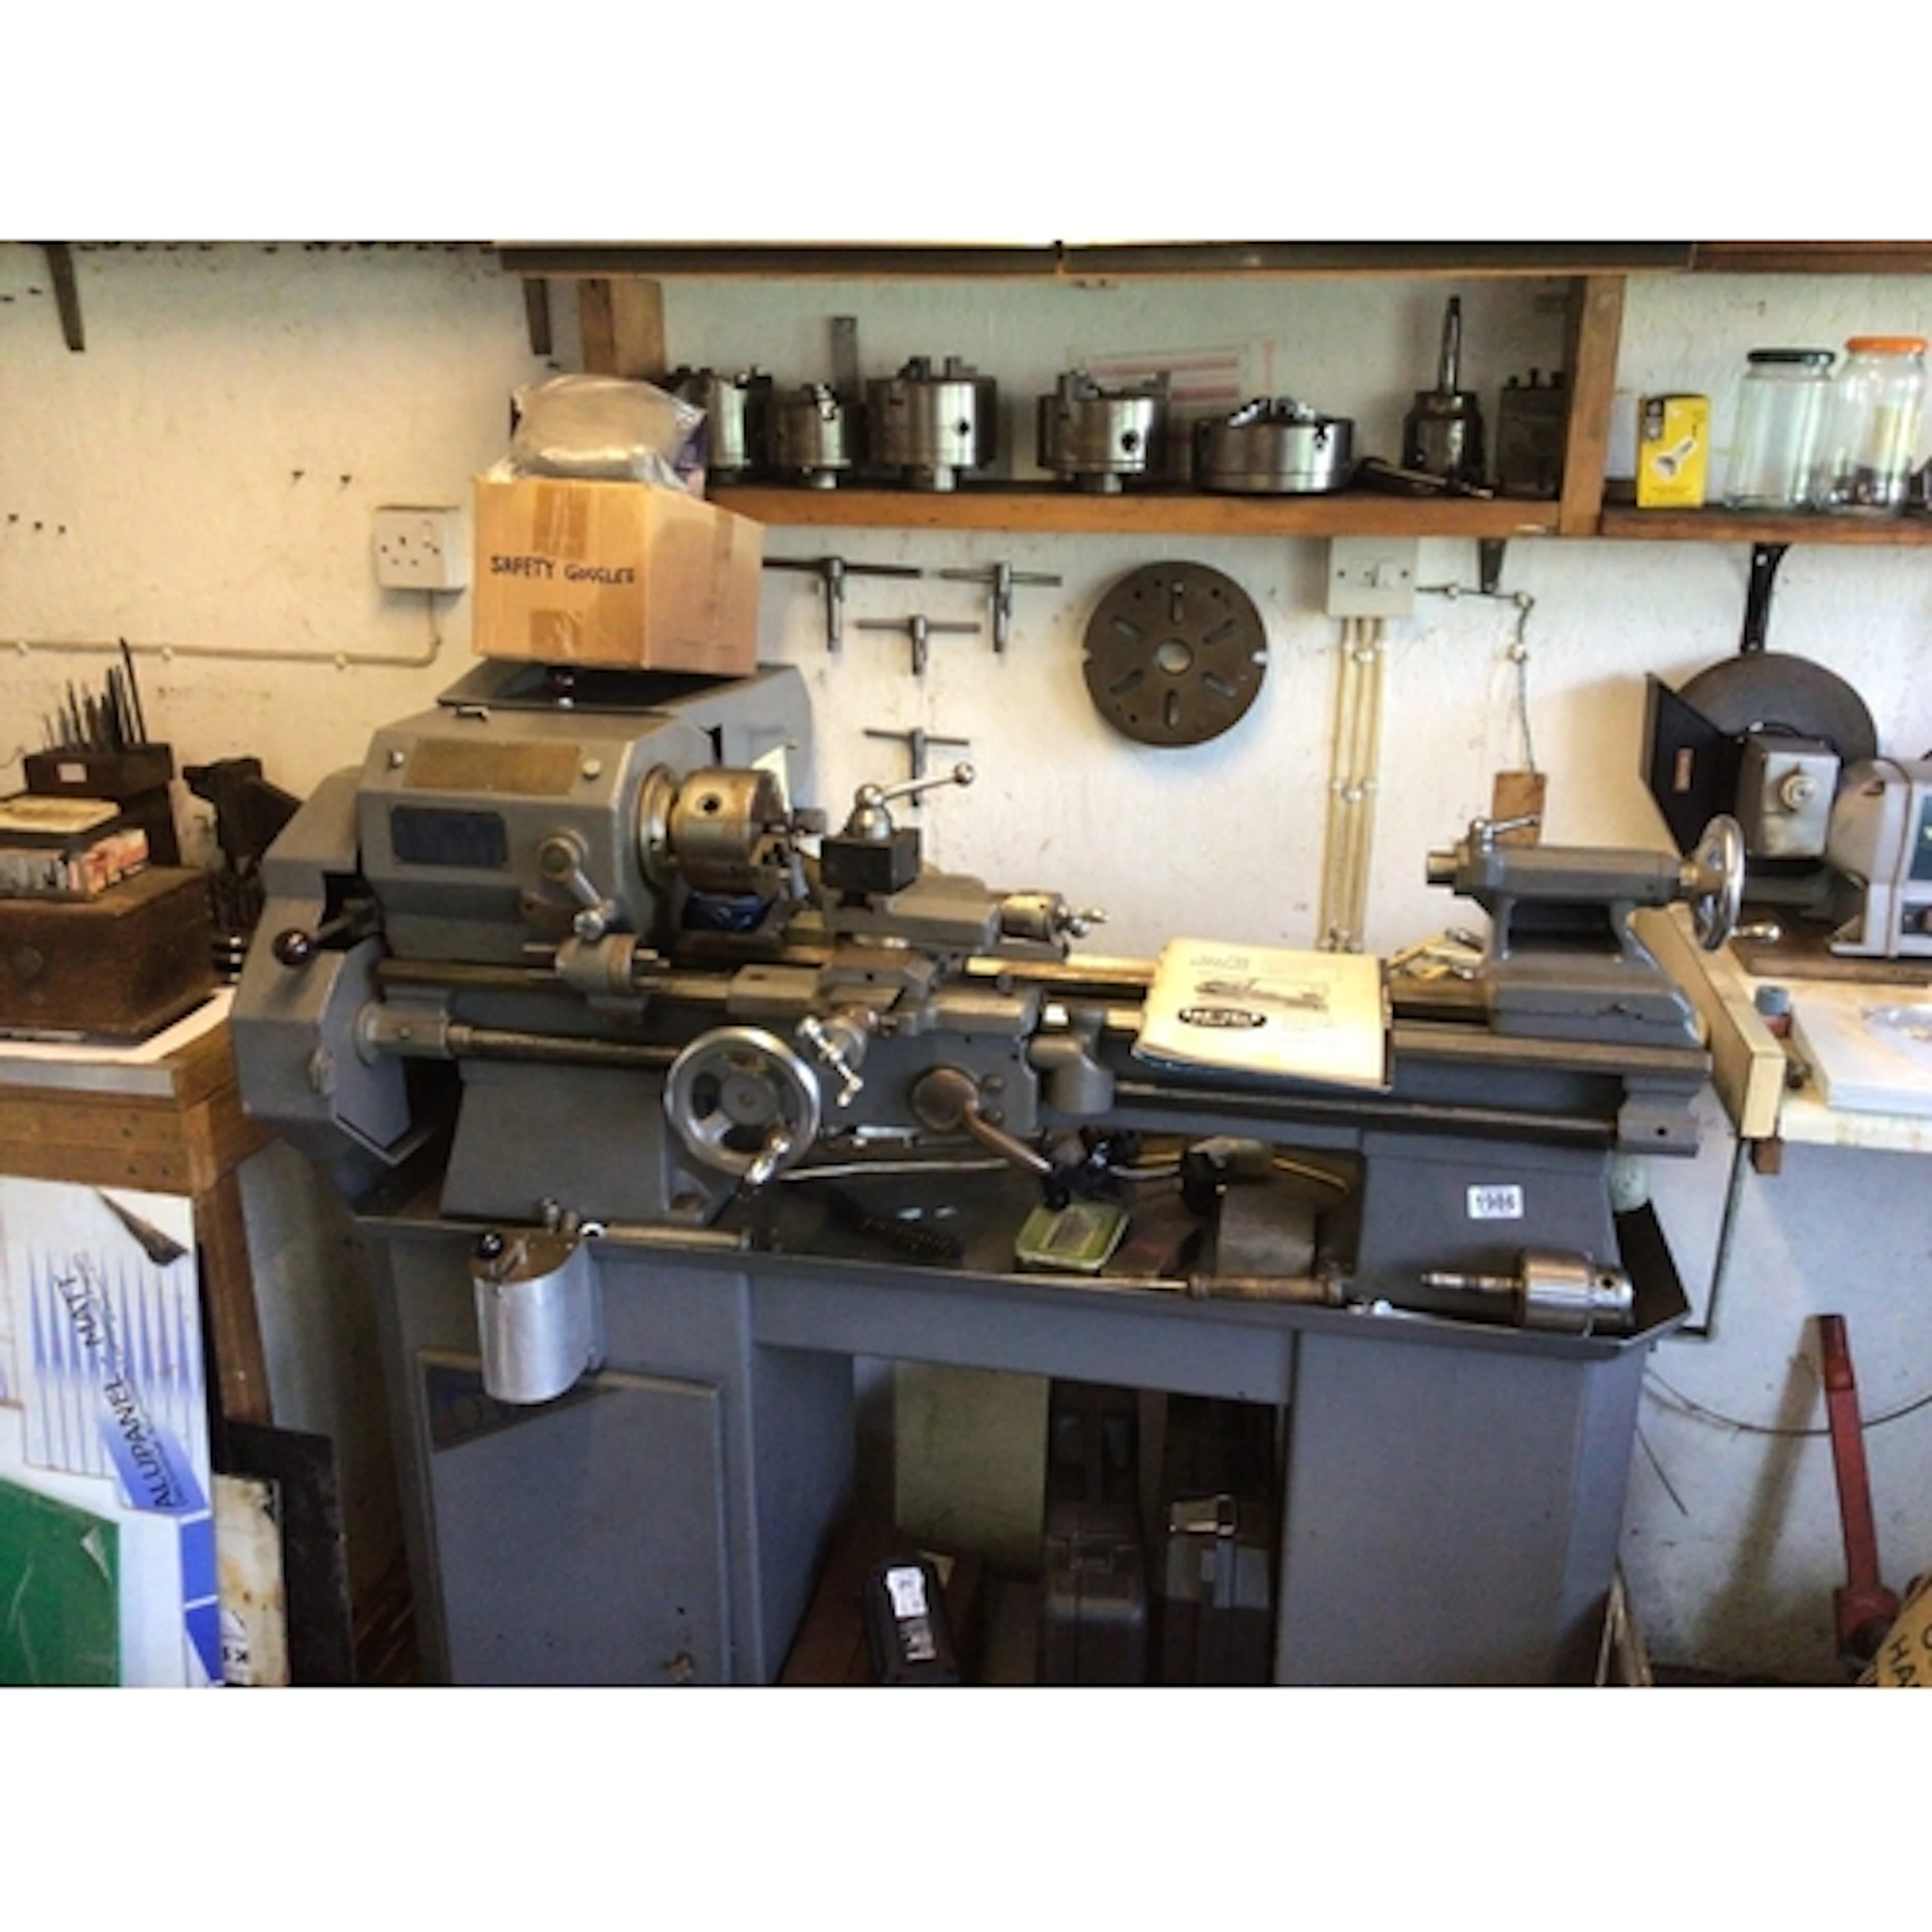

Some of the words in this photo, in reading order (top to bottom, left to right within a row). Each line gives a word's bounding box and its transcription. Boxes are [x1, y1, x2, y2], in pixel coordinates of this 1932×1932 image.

[490, 554, 554, 580] SAFETY
[54, 1271, 102, 1347] MATT
[104, 1372, 175, 1509] ALUPANEL
